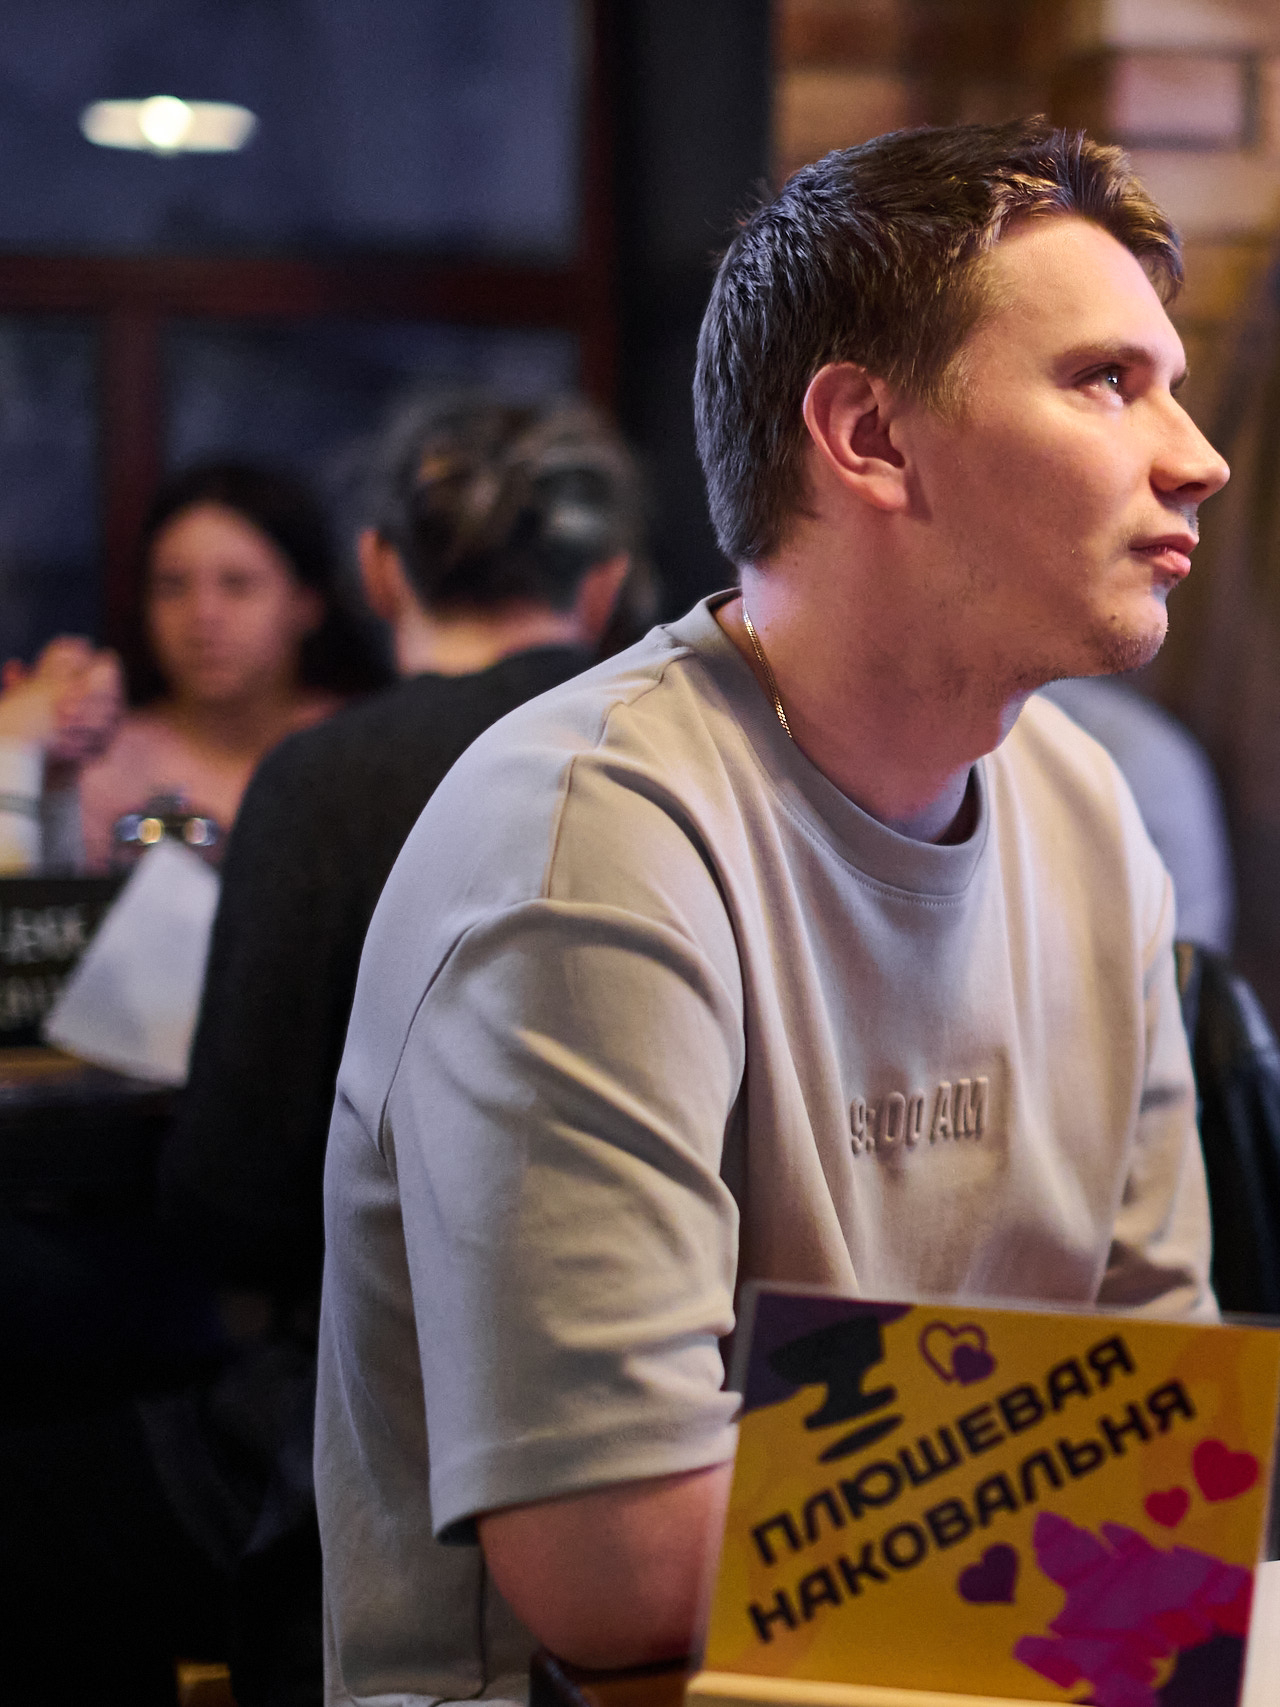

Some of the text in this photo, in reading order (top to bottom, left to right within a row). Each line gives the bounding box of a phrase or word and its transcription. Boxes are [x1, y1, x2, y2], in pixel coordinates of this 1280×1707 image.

[851, 1077, 989, 1156] 9:00 AM
[747, 1378, 1196, 1644] НАКОВАЛЬНЯ
[750, 1334, 1137, 1566] ПЛЮШЕВАЯ
